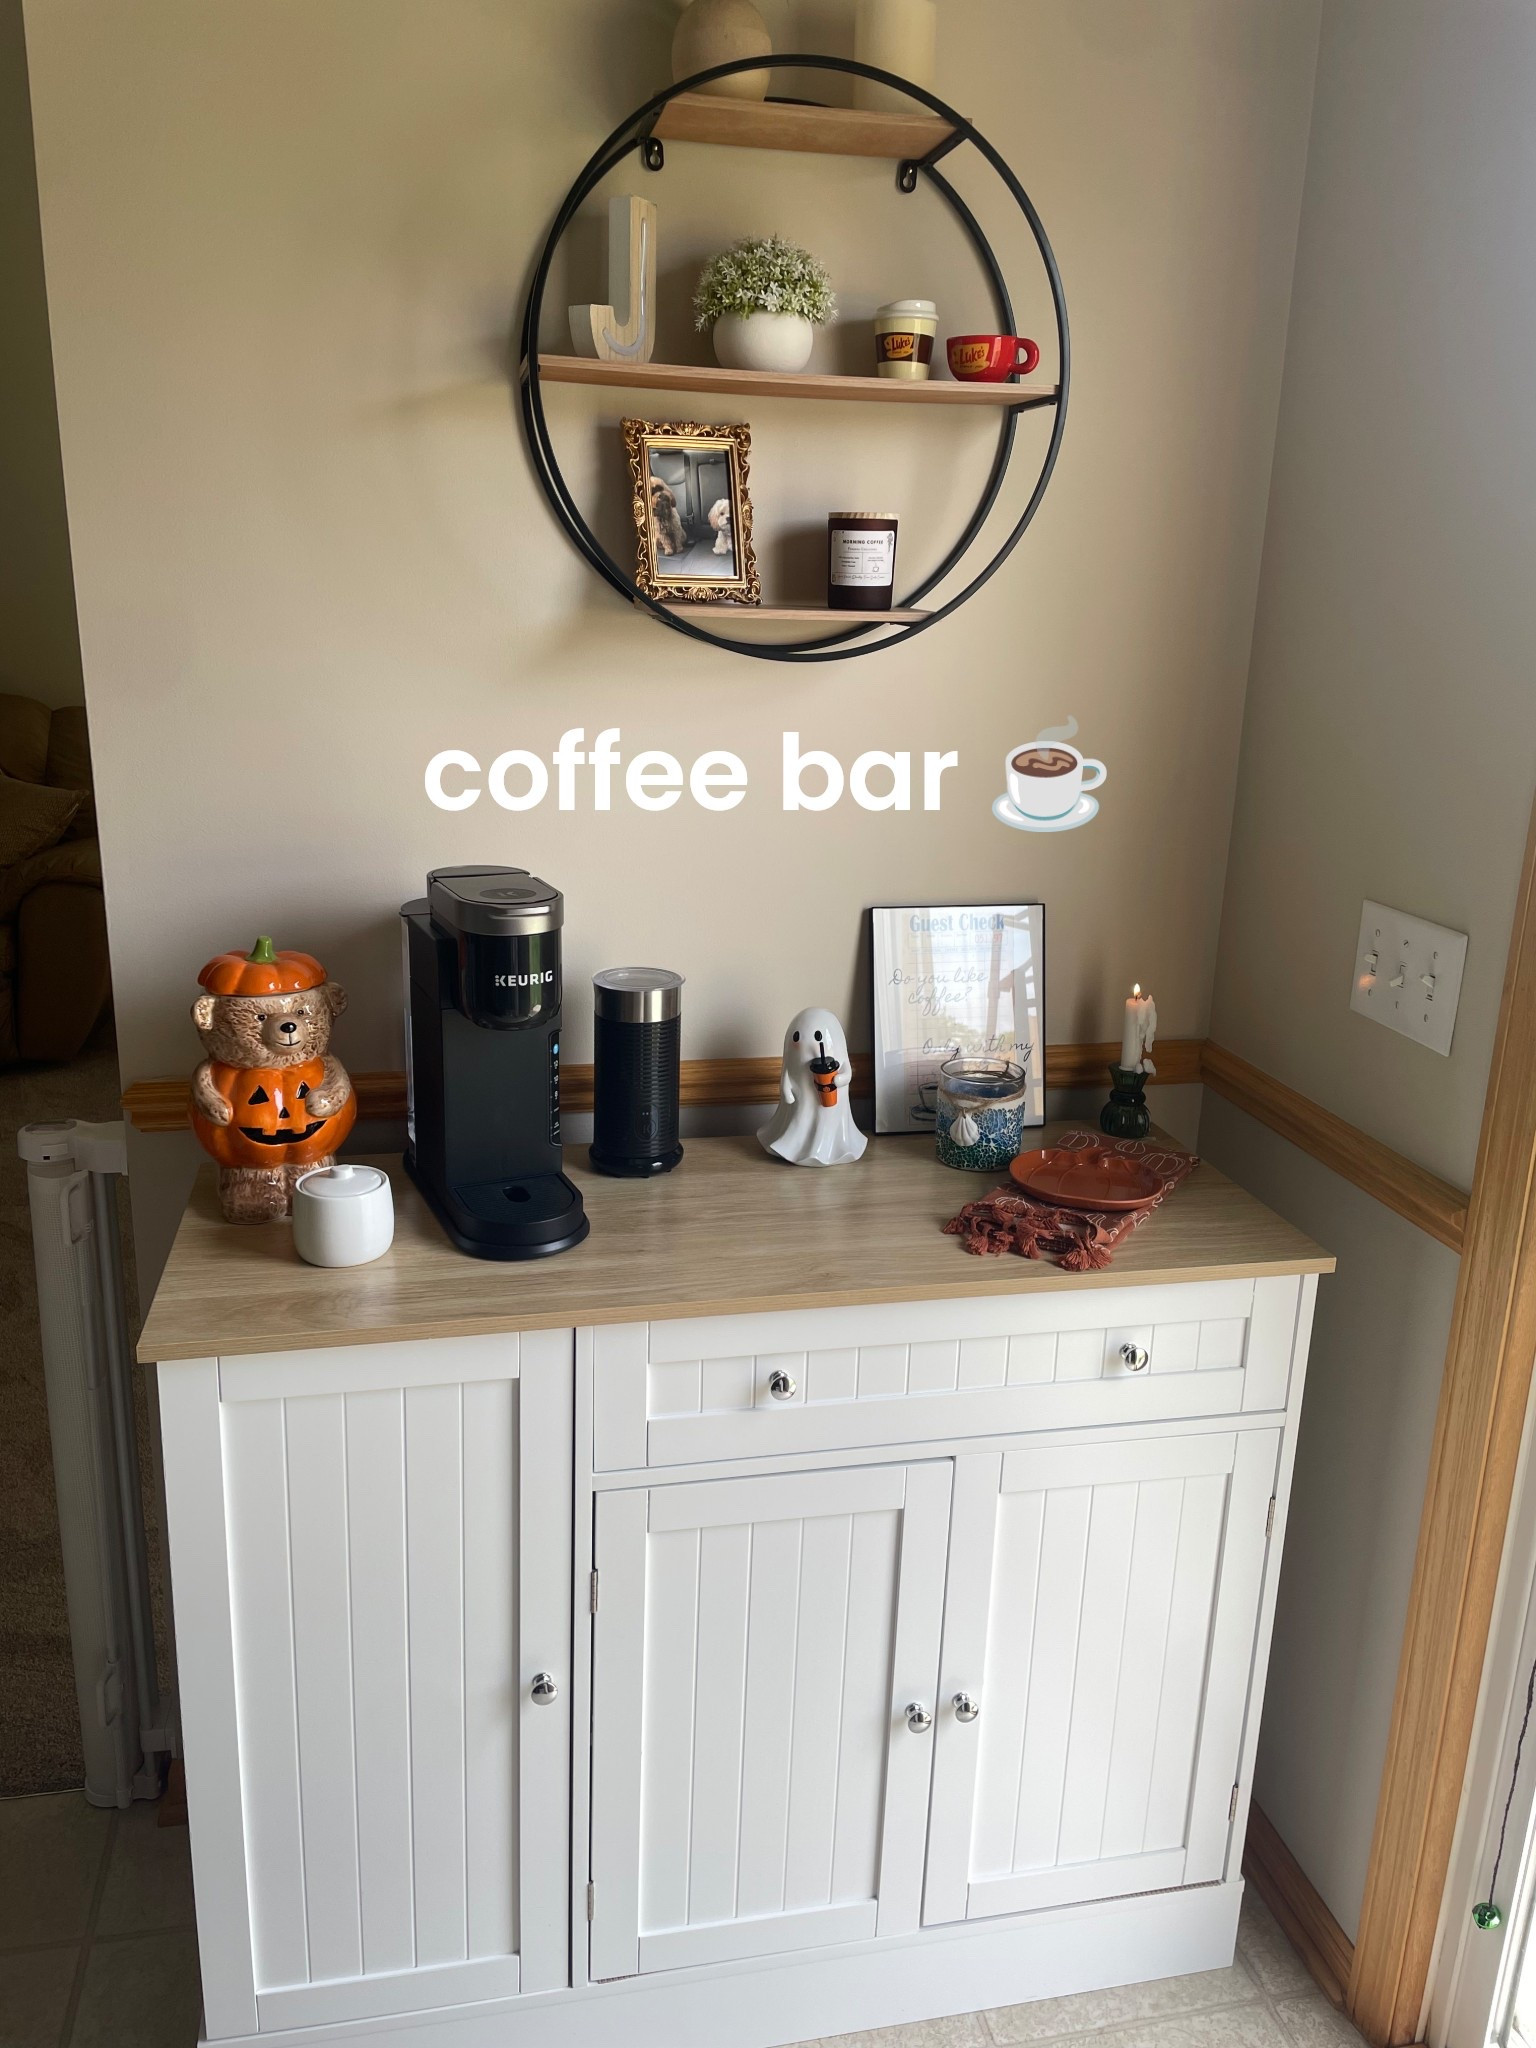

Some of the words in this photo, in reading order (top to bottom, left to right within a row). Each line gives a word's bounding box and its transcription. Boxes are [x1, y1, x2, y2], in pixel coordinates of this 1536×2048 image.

[959, 346, 985, 365] Luke's
[909, 914, 953, 932] Guest
[959, 913, 1005, 931] Check
[494, 970, 553, 987] KEURIG
[888, 968, 913, 986] Do
[915, 974, 949, 996] you
[953, 966, 988, 984] like
[908, 986, 973, 1016] coffee?
[966, 1034, 1005, 1053] with
[1009, 1042, 1034, 1062] my
